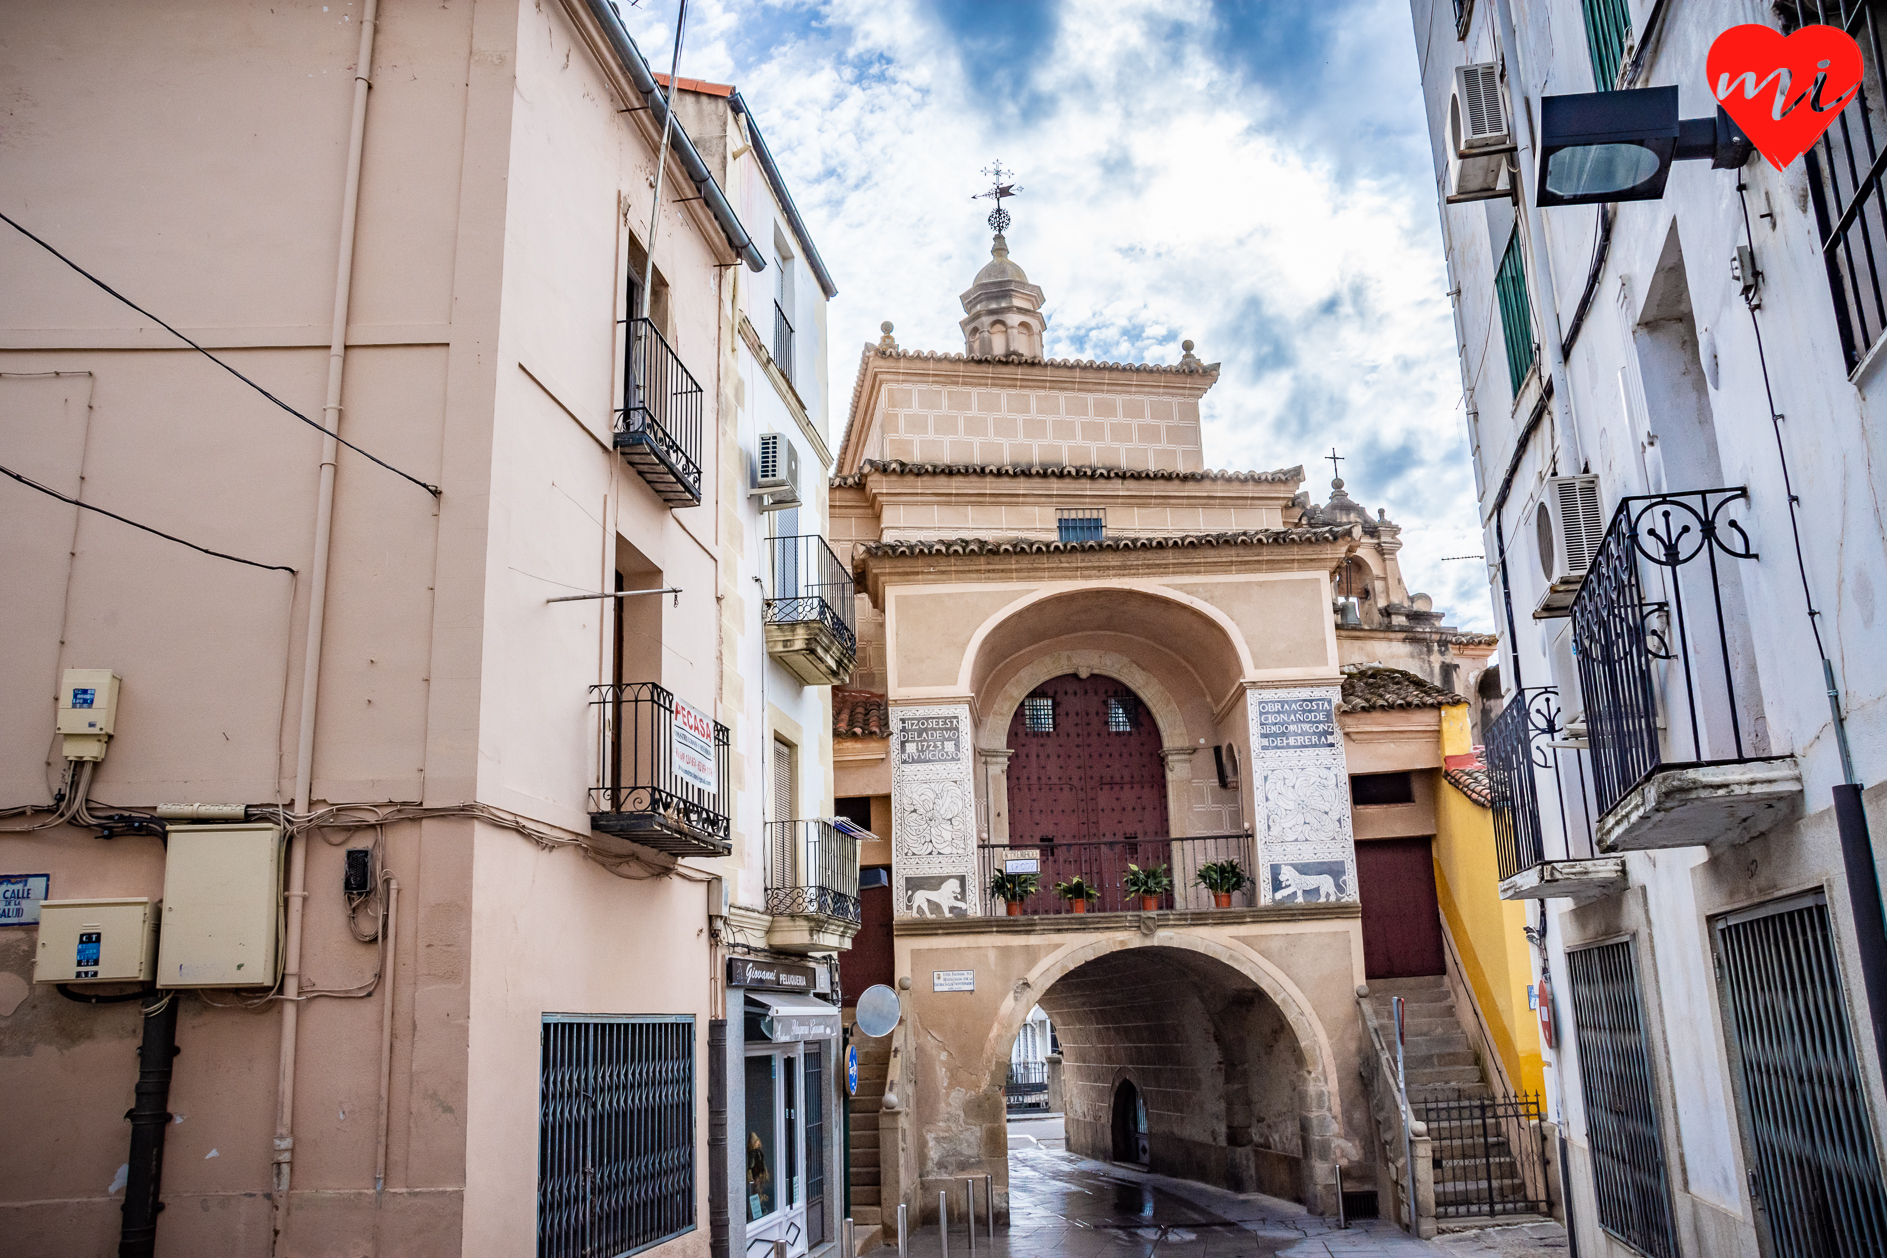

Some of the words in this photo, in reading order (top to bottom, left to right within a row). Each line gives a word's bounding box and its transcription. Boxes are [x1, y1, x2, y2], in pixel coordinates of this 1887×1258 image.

[674, 701, 712, 743] PECASA
[918, 742, 942, 750] 1723
[3, 888, 31, 900] CALLE
[745, 962, 777, 984] Giovanni
[779, 973, 807, 986] PELUQUERIA
